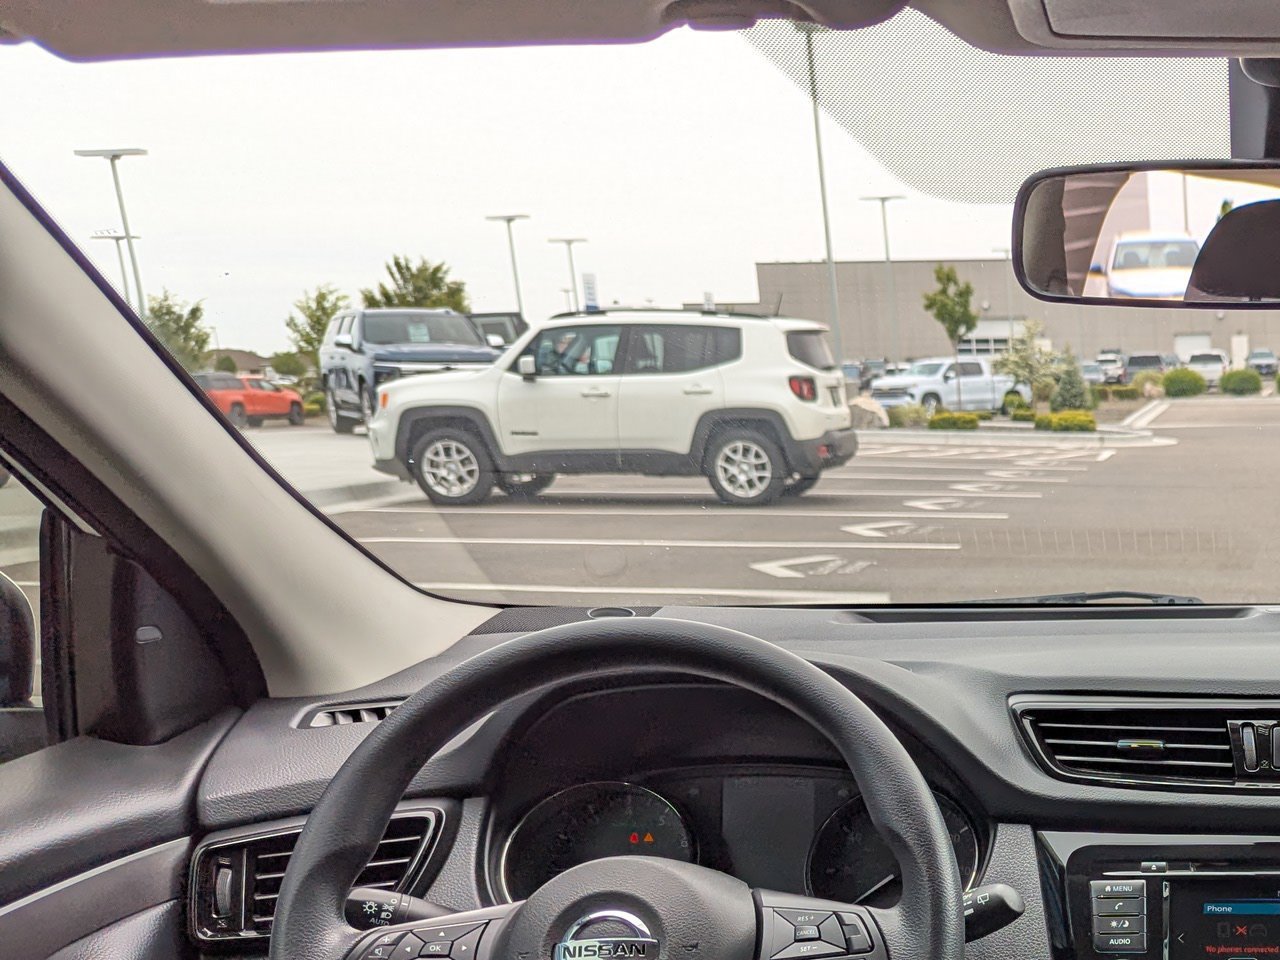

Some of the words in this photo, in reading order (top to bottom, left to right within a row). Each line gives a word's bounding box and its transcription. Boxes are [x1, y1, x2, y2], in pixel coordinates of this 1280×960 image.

[1206, 905, 1233, 913] Phone
[429, 944, 442, 952] OK
[561, 943, 646, 960] NISSAN
